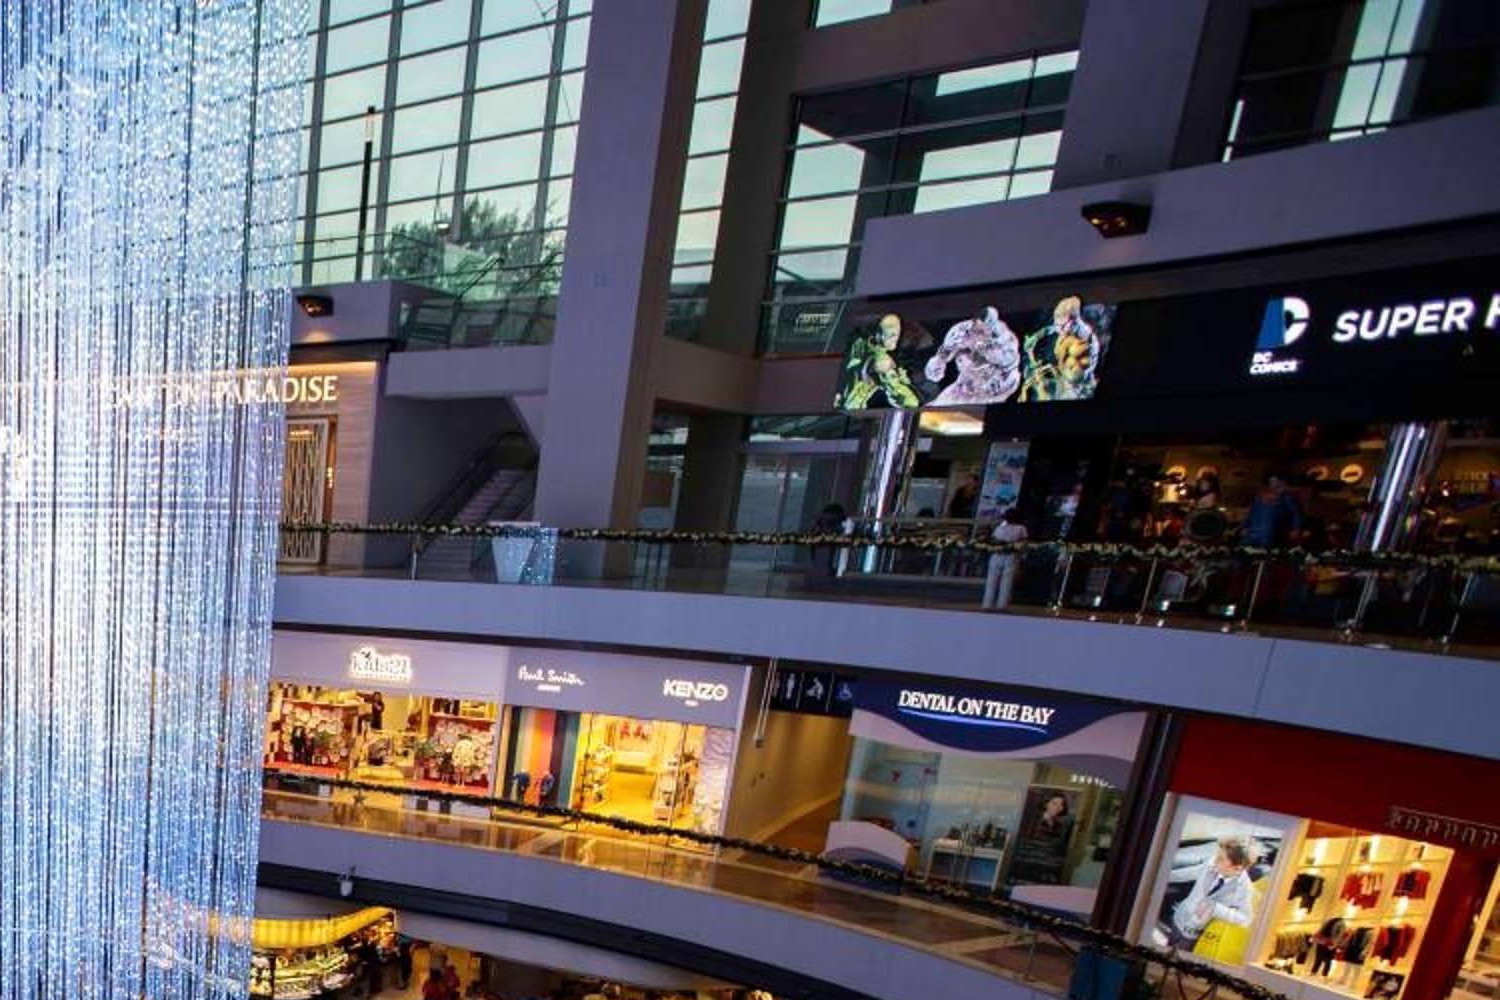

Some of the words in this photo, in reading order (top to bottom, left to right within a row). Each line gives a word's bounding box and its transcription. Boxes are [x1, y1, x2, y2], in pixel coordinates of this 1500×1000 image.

[1331, 299, 1475, 343] SUPER
[663, 679, 729, 701] KENZO
[897, 689, 957, 713] DENTAL
[957, 697, 984, 716] ON
[984, 700, 1019, 723] THE
[1019, 704, 1055, 726] BAY
